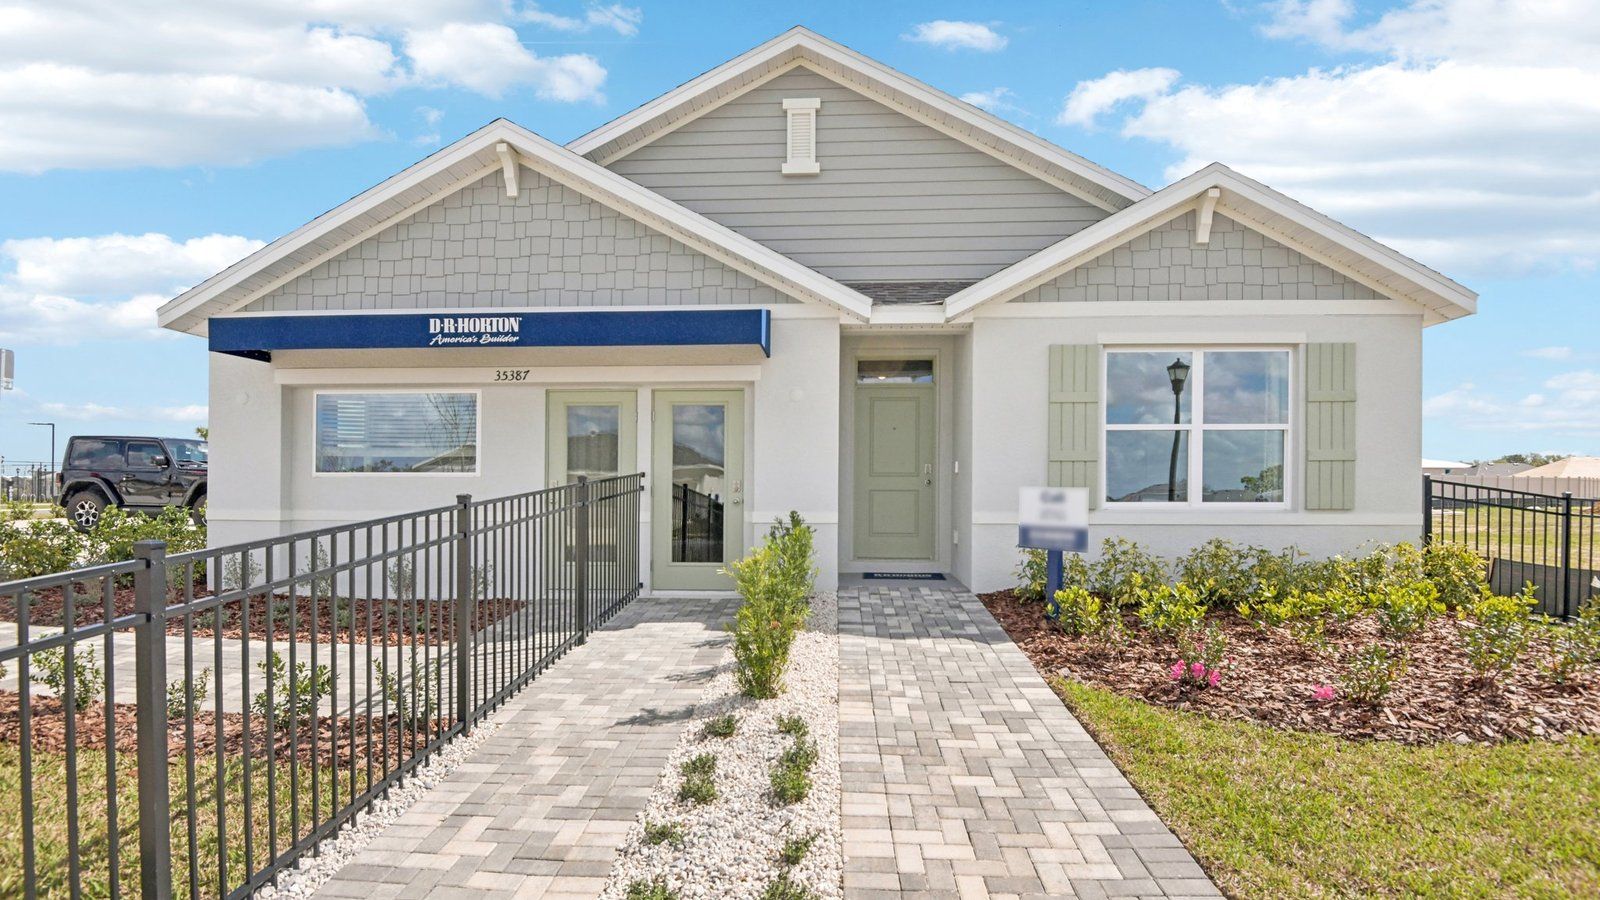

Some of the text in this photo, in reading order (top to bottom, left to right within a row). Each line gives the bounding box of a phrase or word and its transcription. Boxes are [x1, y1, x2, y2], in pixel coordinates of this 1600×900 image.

[429, 334, 520, 346] America's Builder
[494, 369, 531, 381] 35387
